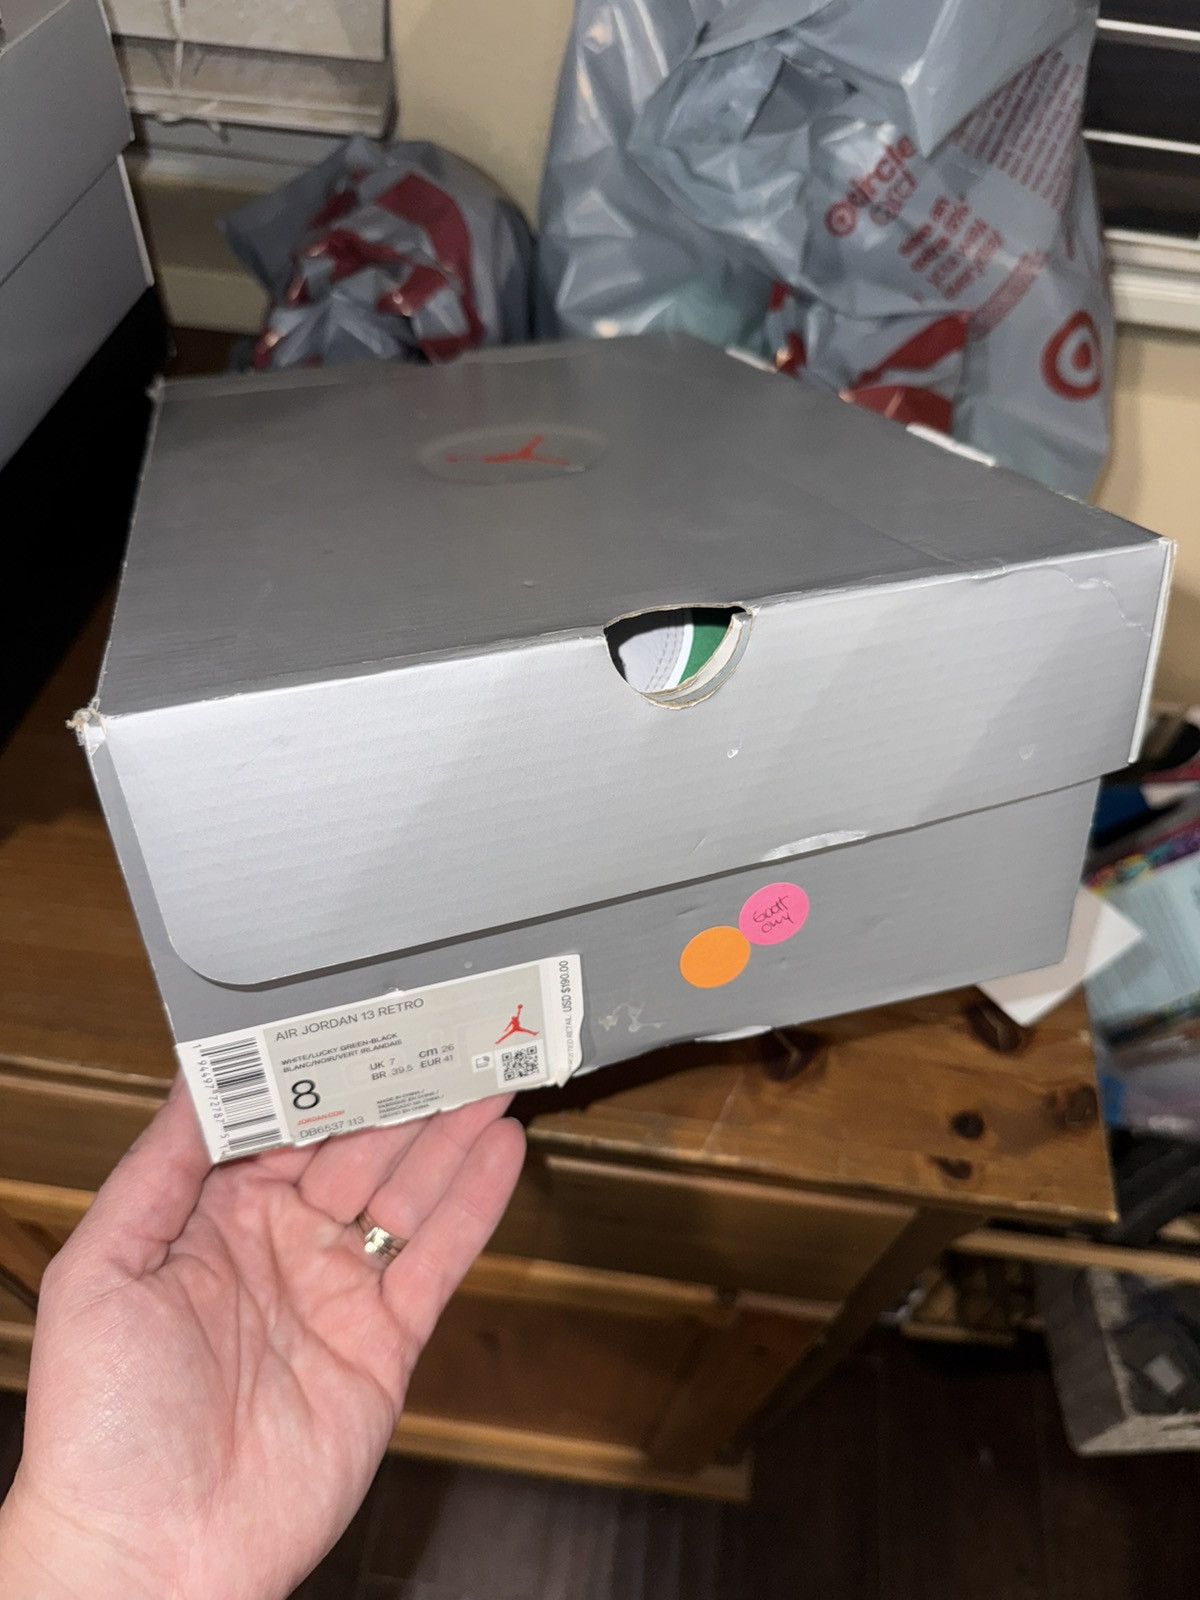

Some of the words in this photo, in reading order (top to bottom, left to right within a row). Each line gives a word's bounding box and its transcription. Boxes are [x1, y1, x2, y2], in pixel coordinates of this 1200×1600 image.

[559, 960, 571, 994] $190.00
[562, 995, 572, 1013] USD
[275, 1028, 298, 1042] AIR
[302, 1013, 358, 1036] JORDAN
[361, 1009, 376, 1021] 13
[378, 998, 425, 1017] RETRO
[280, 1047, 338, 1066] WHITE/LUCKY
[340, 1032, 398, 1051] GREEN-BLACK
[283, 1049, 358, 1073] BLANC/NOIR/VERT
[418, 1047, 438, 1058] cm
[441, 1043, 455, 1053] 26
[370, 1060, 385, 1070] UK
[389, 1057, 396, 1065] 7
[371, 1070, 387, 1080] BR
[391, 1064, 414, 1076] 39.5
[420, 1056, 441, 1068] EUR
[443, 1054, 454, 1062] 41
[291, 1079, 321, 1110] 8
[300, 1120, 345, 1138] DB6537
[348, 1115, 365, 1126] 113
